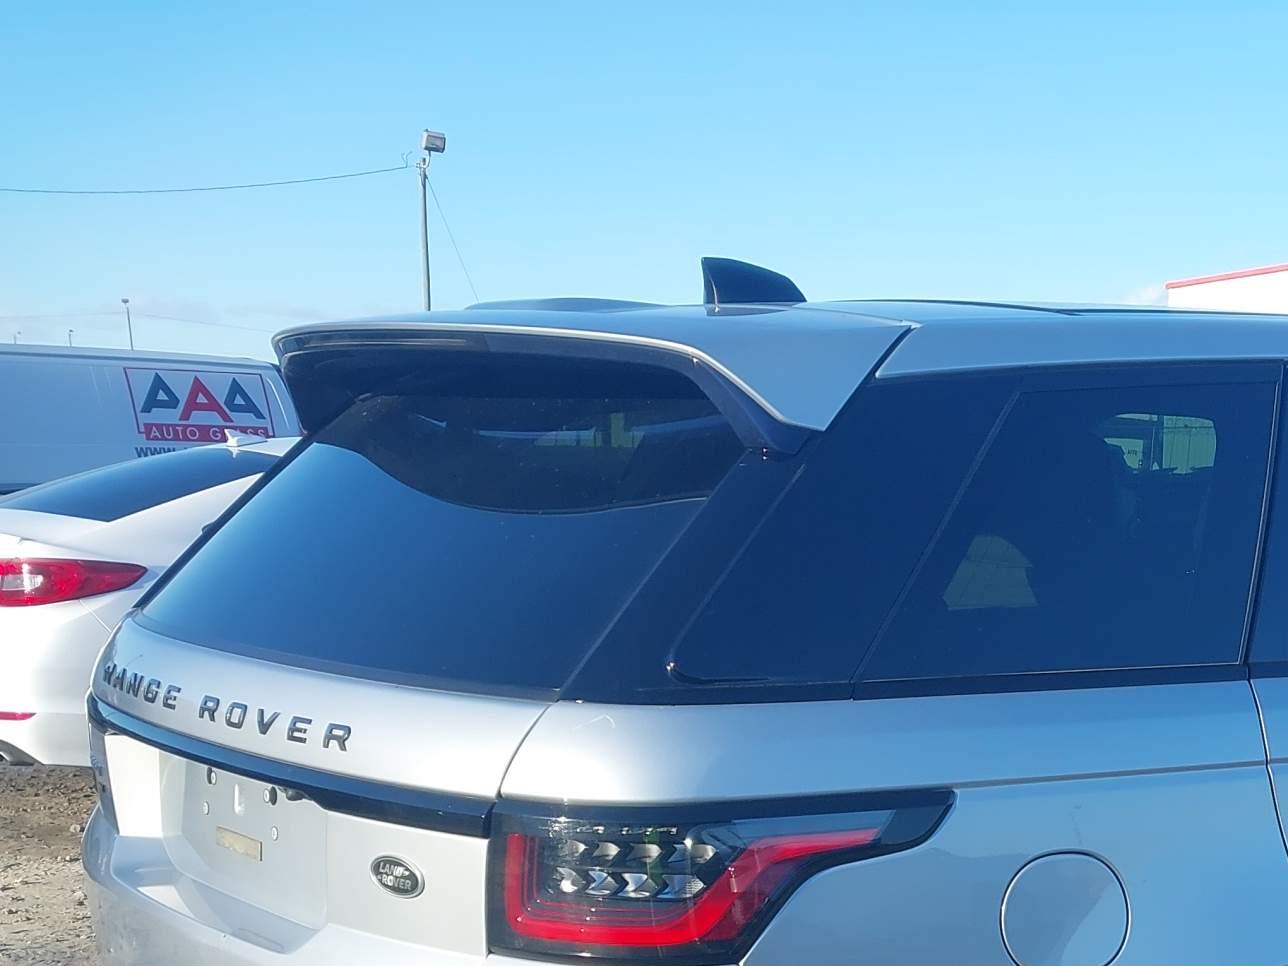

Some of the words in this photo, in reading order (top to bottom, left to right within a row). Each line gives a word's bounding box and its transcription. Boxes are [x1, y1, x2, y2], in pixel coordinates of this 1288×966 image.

[150, 426, 199, 440] AUTO
[209, 427, 265, 440] GSS
[103, 663, 182, 711] RANGE
[198, 695, 351, 752] ROVER
[379, 861, 405, 878] LAND
[380, 873, 412, 890] ROVER
